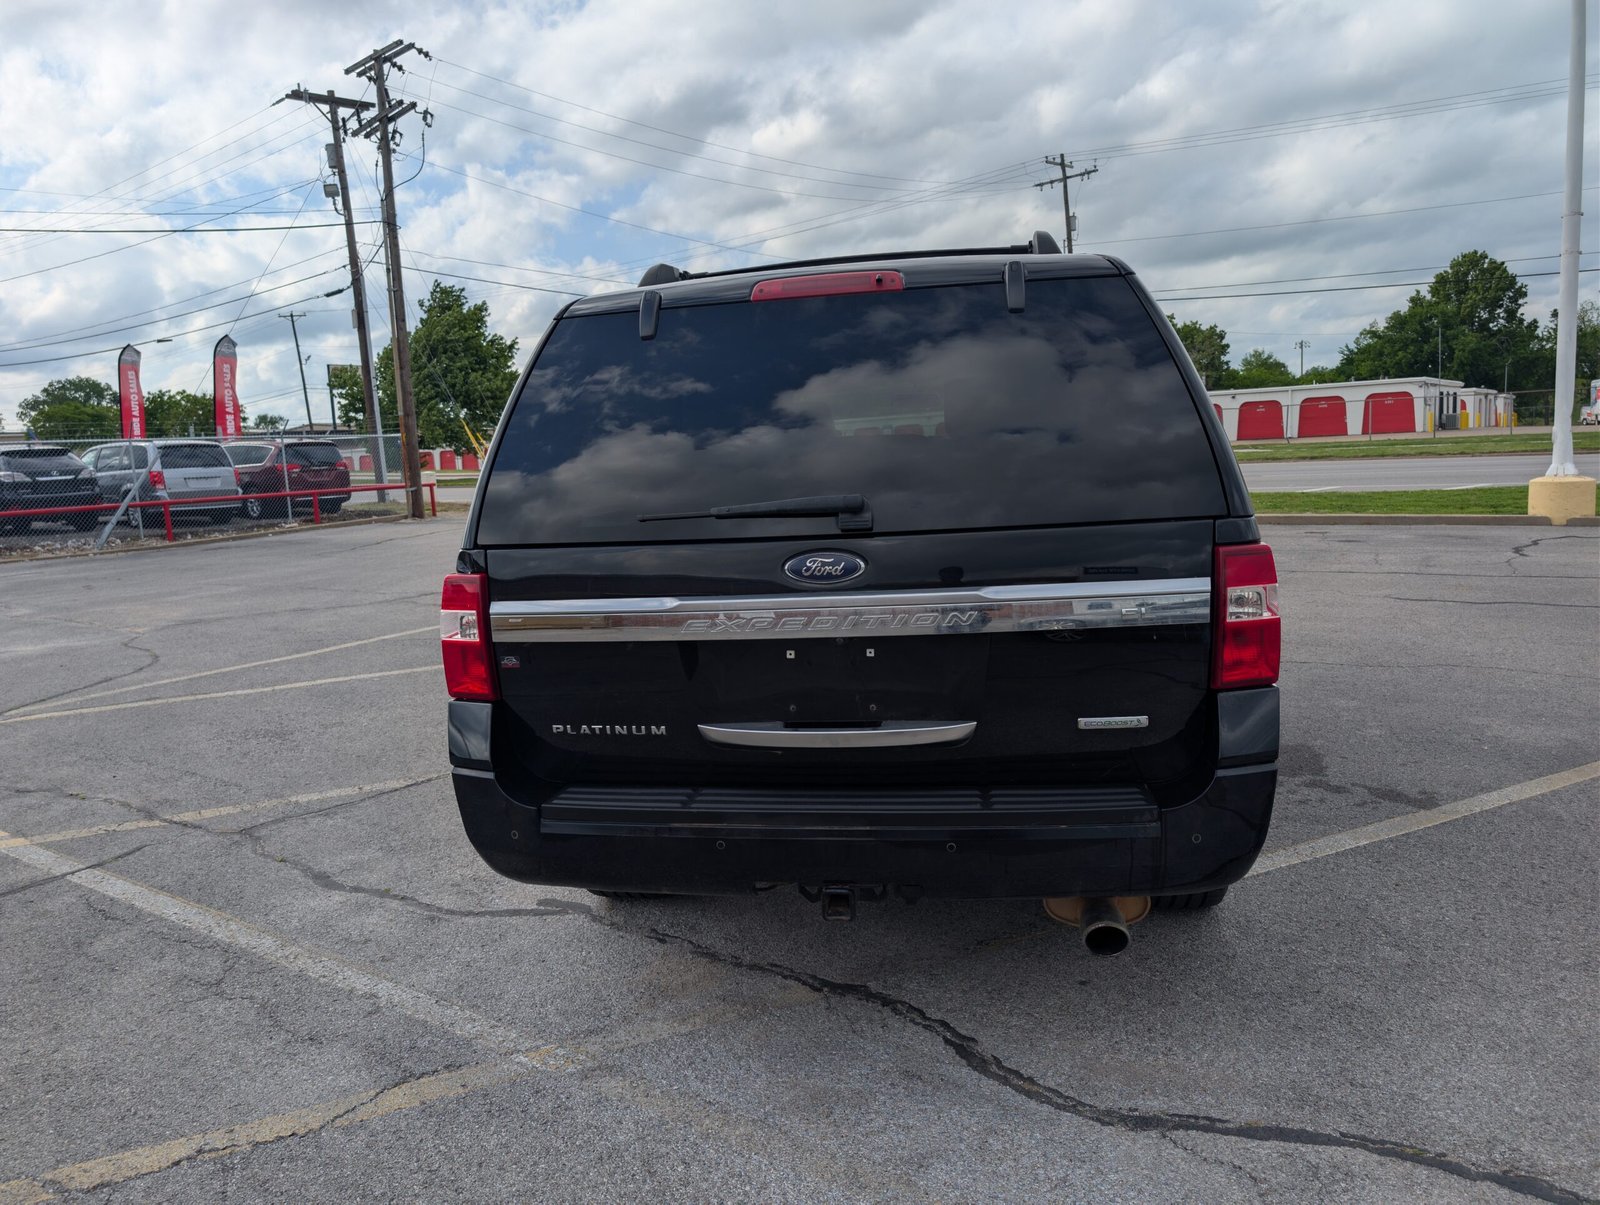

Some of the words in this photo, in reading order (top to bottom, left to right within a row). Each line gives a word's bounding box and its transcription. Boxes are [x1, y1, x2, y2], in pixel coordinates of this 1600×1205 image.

[128, 371, 137, 393] SALES
[223, 364, 231, 388] SALES
[131, 393, 139, 417] AUTO
[225, 388, 234, 413] AUTO
[132, 417, 141, 435] RIDE
[802, 557, 845, 576] Ford
[680, 610, 979, 633] EXPEDITION
[551, 724, 667, 736] PLATINUM
